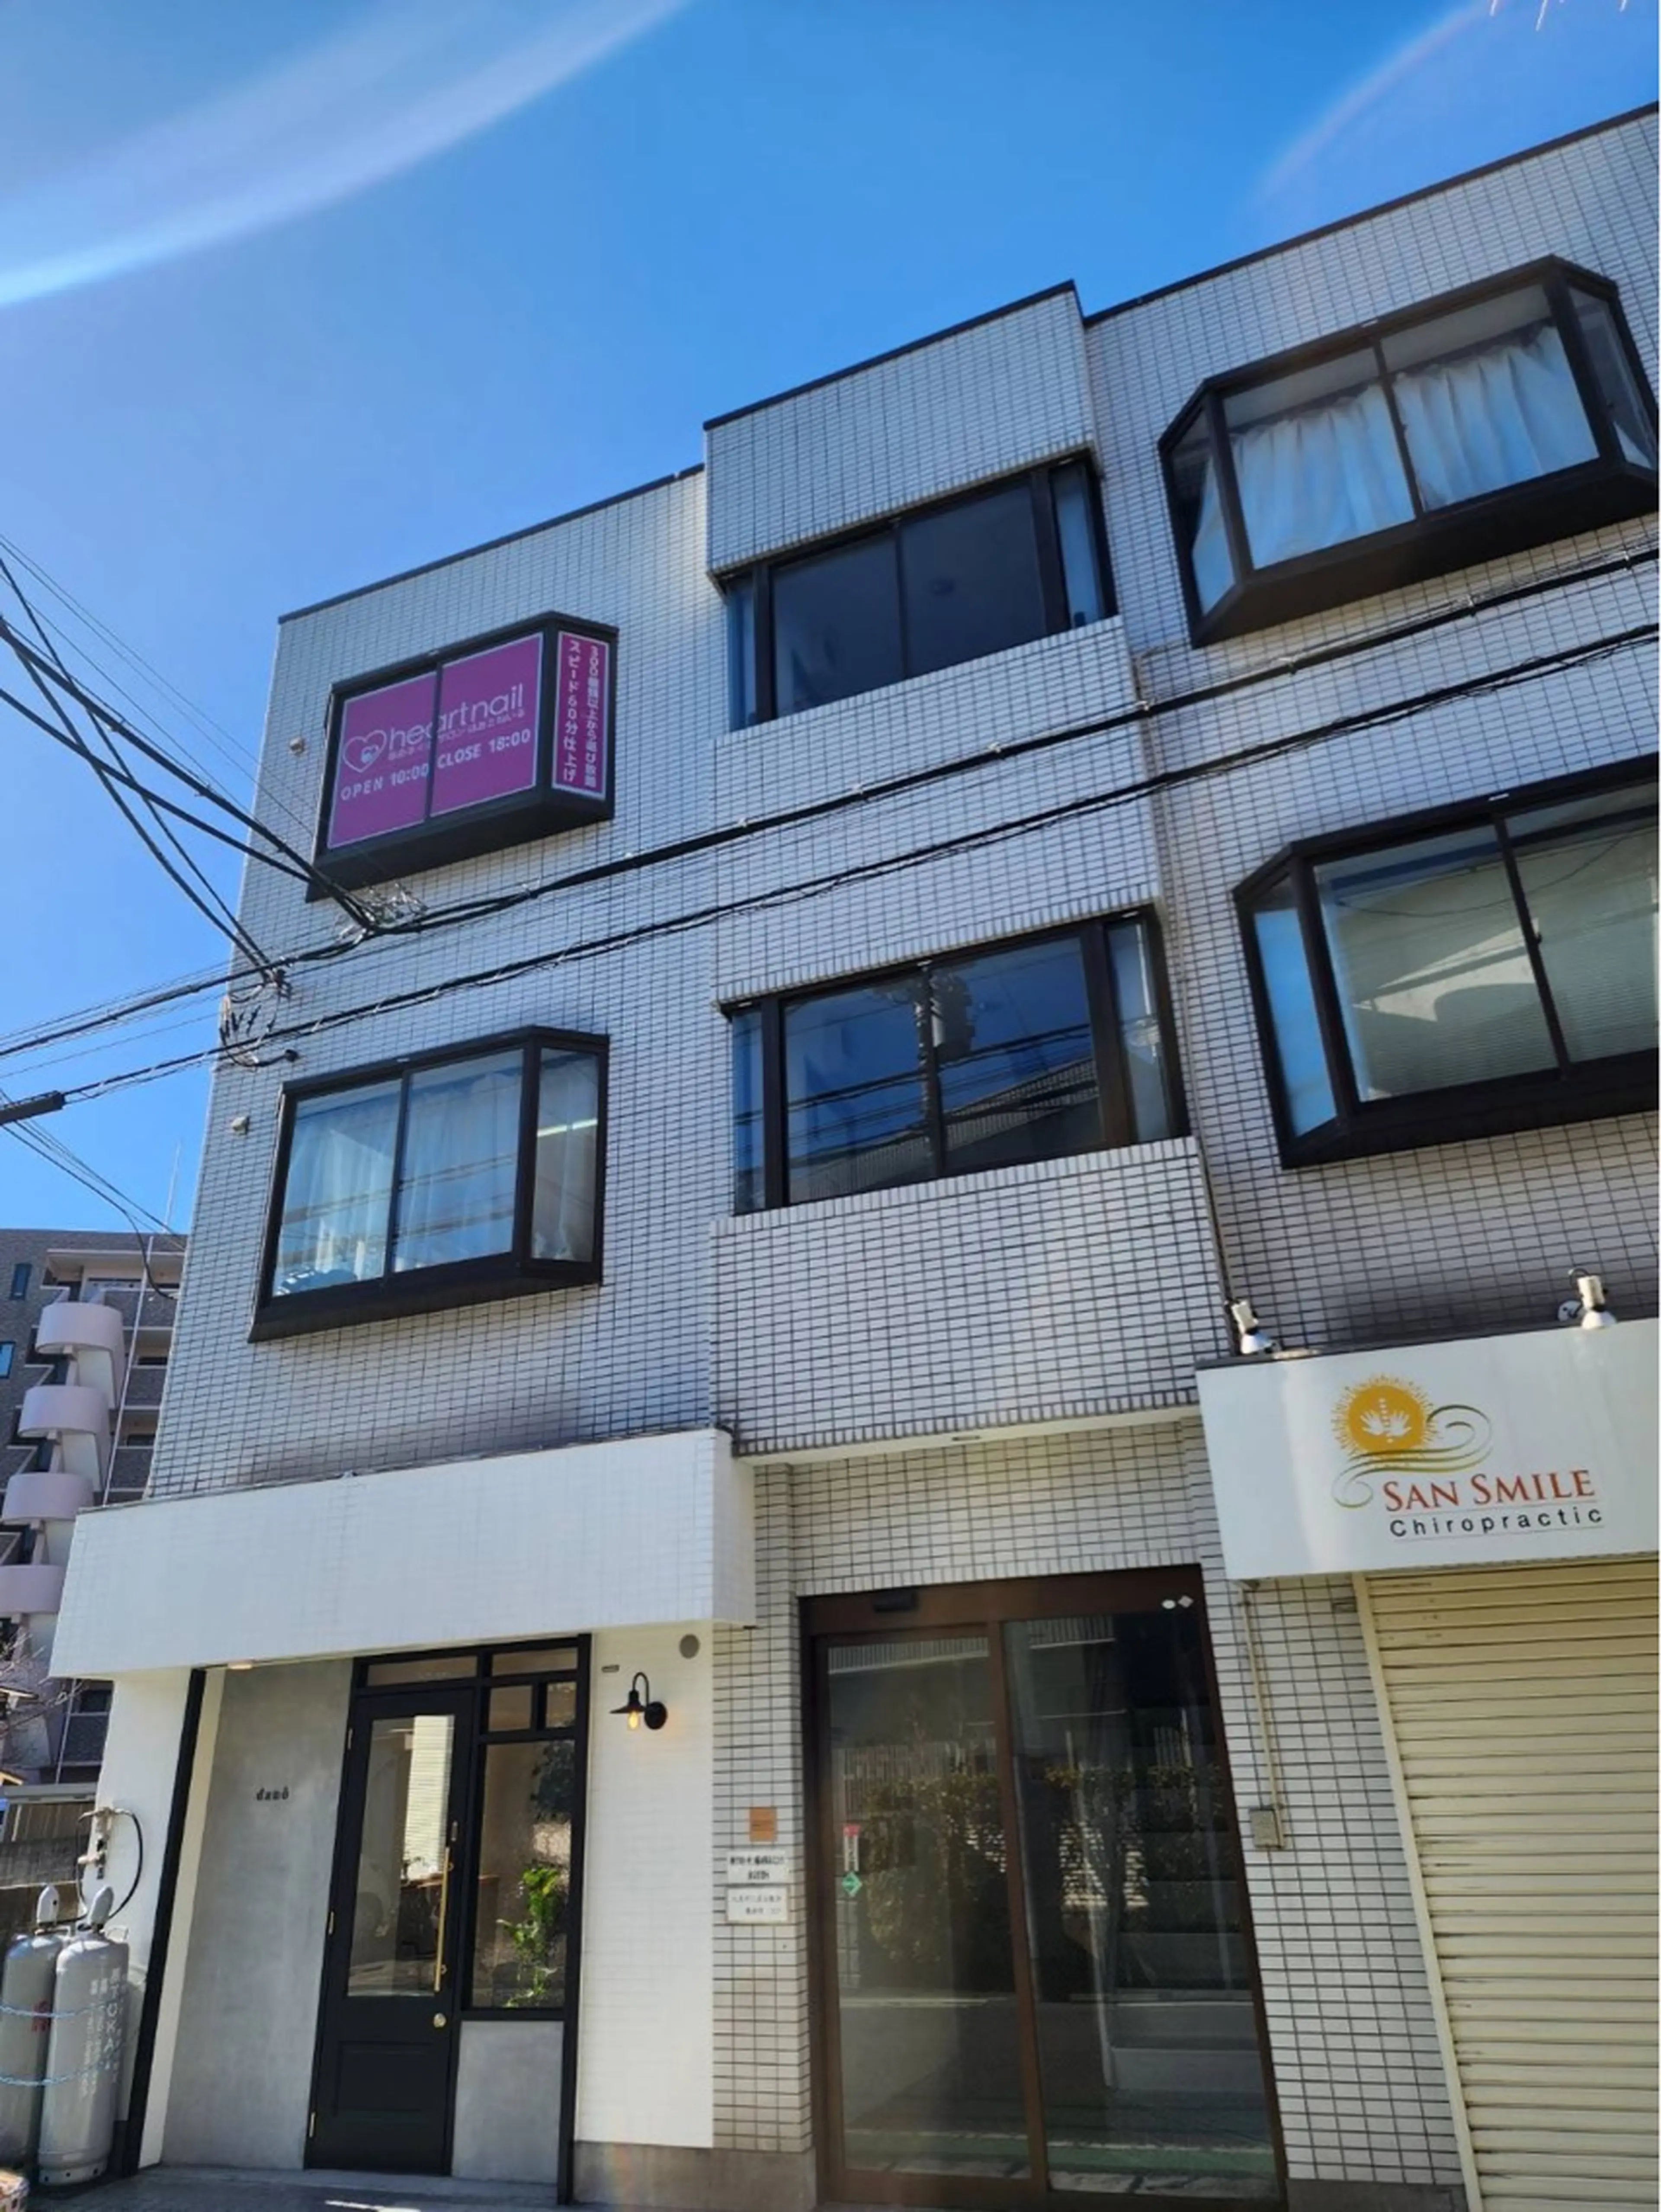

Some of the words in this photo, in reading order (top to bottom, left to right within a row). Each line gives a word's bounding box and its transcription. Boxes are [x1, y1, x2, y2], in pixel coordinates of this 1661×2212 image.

[340, 776, 383, 801] OPEN
[391, 763, 430, 786] 10:00
[437, 743, 482, 769] CLOSE
[1383, 1481, 1459, 1512] SAN
[1470, 1469, 1595, 1505] SMILE
[1390, 1506, 1602, 1537] Chiropractic
